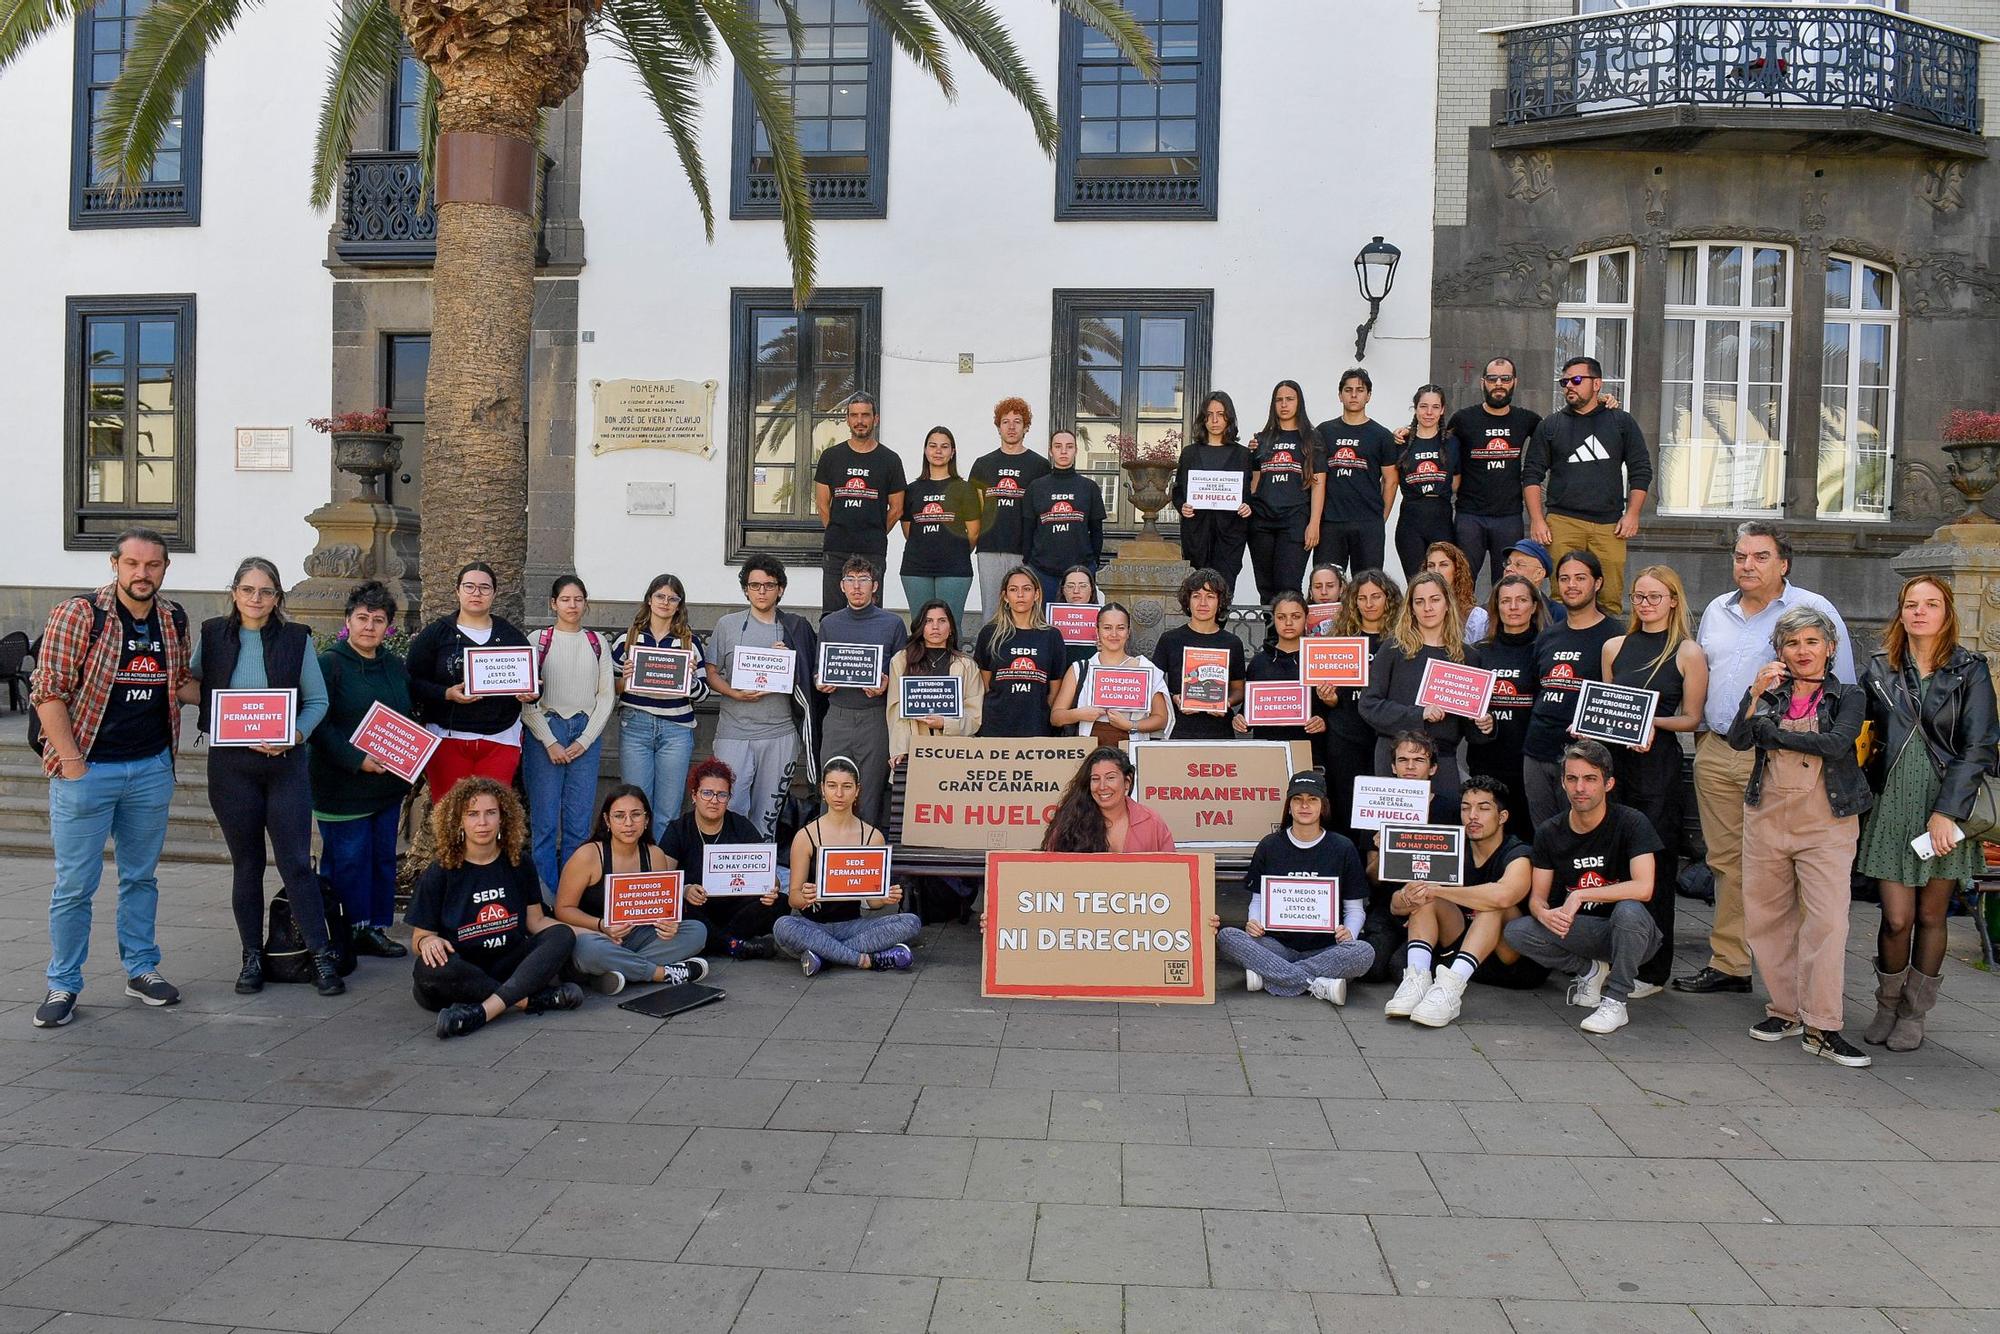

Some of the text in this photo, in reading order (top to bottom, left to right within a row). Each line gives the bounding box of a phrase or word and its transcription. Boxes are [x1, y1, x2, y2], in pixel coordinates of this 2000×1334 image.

[618, 415, 635, 424] JOSÉ
[1489, 440, 1505, 450] EAC
[1337, 449, 1353, 459] EAC
[1415, 452, 1439, 460] SEDE
[1487, 461, 1505, 470] ¡YA!
[847, 468, 870, 476] SEDE
[998, 469, 1020, 477] SEDE
[1336, 469, 1352, 477] ¡YA!
[848, 480, 864, 488] EAC
[1272, 474, 1288, 483] ¡YA!
[1000, 480, 1016, 489] EAC
[844, 500, 862, 508] ¡YA!
[924, 504, 941, 513] EAC
[1054, 503, 1072, 512] EAC
[923, 525, 940, 533] ¡YA!
[1053, 524, 1069, 533] ¡YA!
[1553, 652, 1581, 660] SEDE
[132, 658, 155, 671] EAC
[1014, 658, 1032, 669] EAC
[1552, 666, 1570, 677] EAC
[1444, 673, 1473, 683] ESTUDIOS
[1011, 683, 1031, 693] ¡YA!
[126, 689, 152, 701] ¡YA!
[1543, 692, 1564, 702] ¡YA!
[1602, 691, 1634, 701] ESTUDIOS
[1592, 698, 1630, 709] SUPERIORES
[1604, 709, 1642, 720] DRAMÁTICO
[244, 723, 260, 732] ¡YA!
[1584, 715, 1639, 731] PÚBLICOS
[374, 724, 410, 747] SUPERIORES
[386, 722, 416, 741] ESTUDIOS
[367, 730, 417, 760] ARTE DRAMÁTICO
[369, 741, 404, 764] PÚBLICOS
[915, 748, 1086, 760] ESCUELA DE ACTORES
[966, 770, 1033, 781] SEDE DE
[1187, 763, 1238, 777] SEDE
[938, 781, 1060, 792] GRAN CANARIA
[1145, 786, 1281, 801] PERMANENTE
[914, 803, 1061, 825] EN HUELG
[1195, 810, 1233, 828] ¡YA!
[1360, 809, 1420, 821] EN HUELGA
[1574, 856, 1604, 869] SEDE
[1581, 873, 1602, 887] EAC
[473, 888, 506, 903] SEDE
[1018, 890, 1171, 915] SIN TECHO
[481, 906, 505, 922] EAC
[624, 907, 664, 916] PÚBLICOS
[484, 935, 506, 948] ¡YA!
[998, 928, 1191, 952] NI DERECHOS
